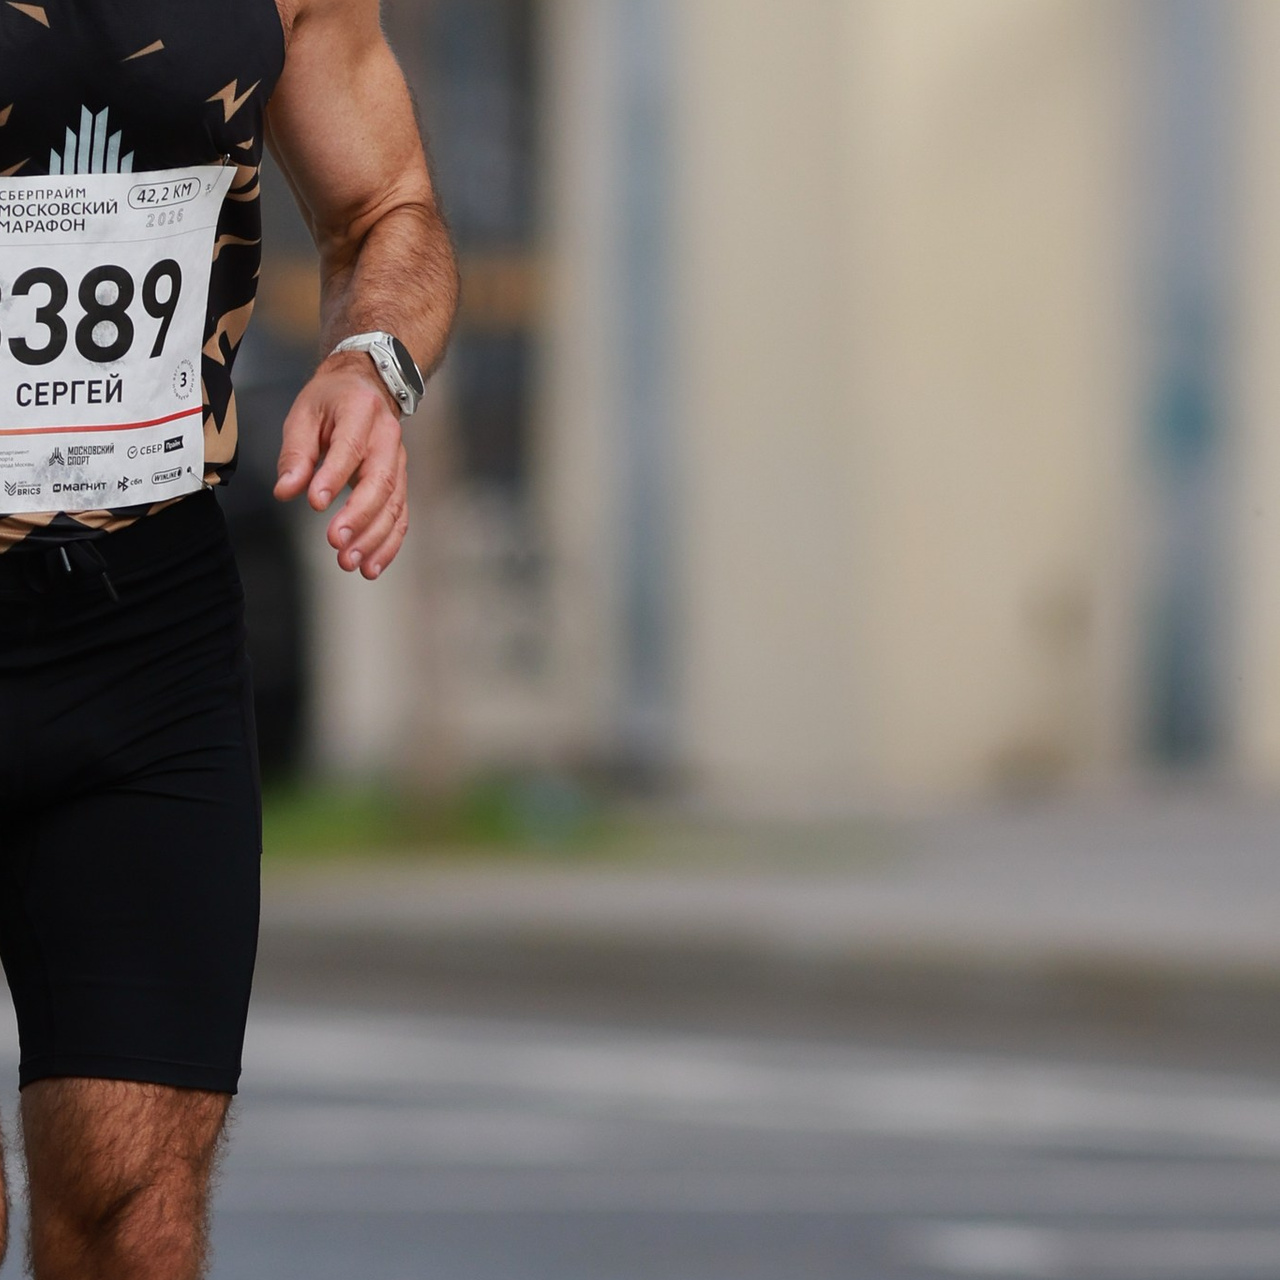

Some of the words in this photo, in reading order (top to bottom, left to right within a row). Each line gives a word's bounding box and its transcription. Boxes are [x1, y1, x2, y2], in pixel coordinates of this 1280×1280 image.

[136, 186, 169, 204] 42,2
[179, 371, 187, 388] 3
[16, 373, 124, 407] СЕРГЕЙ
[67, 442, 115, 456] МОСКОВСКИЙ
[140, 443, 163, 456] СБЕР
[67, 455, 90, 466] СПОРТ
[17, 487, 41, 496] BRICS
[63, 481, 107, 492] магнит
